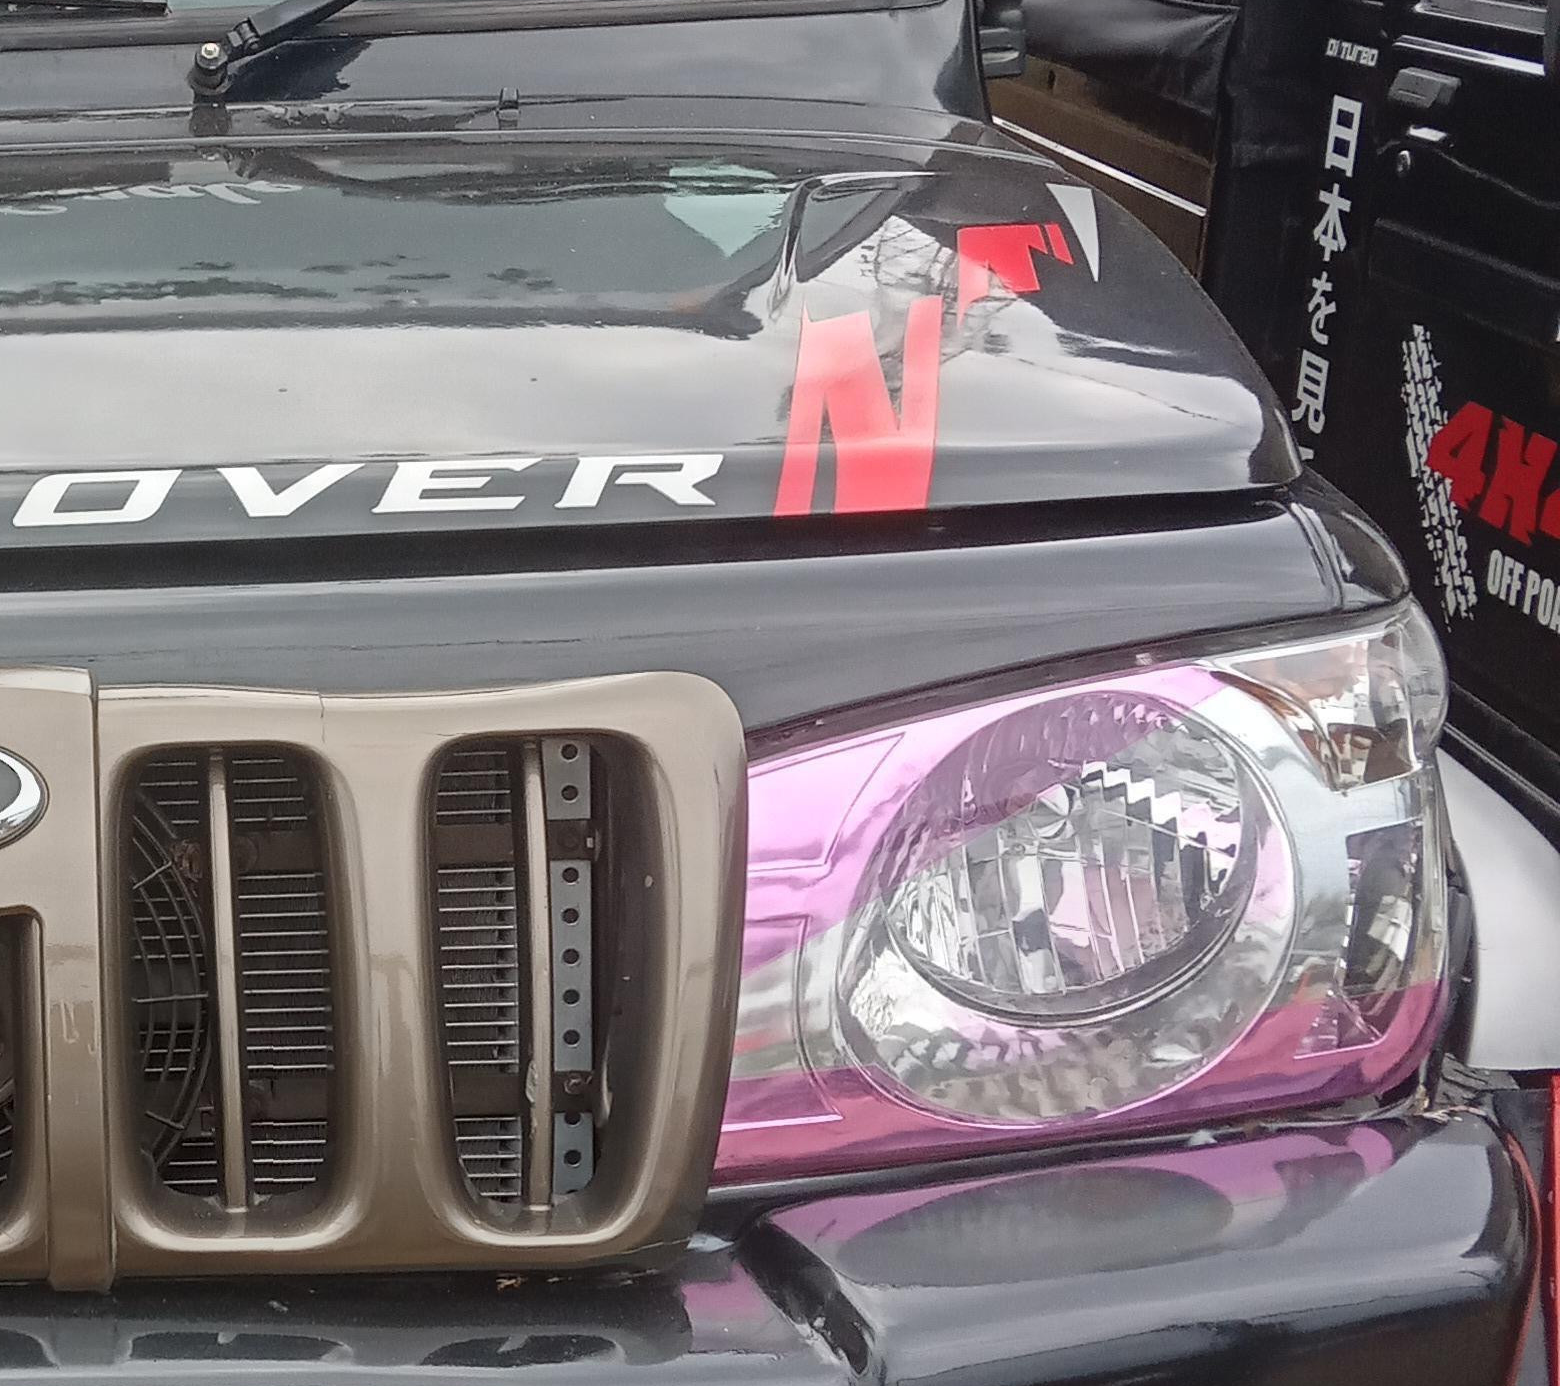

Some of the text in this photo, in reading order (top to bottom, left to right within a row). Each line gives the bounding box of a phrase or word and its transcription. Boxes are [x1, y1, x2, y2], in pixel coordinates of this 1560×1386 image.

[1291, 94, 1363, 461] 日本を見
[1487, 549, 1525, 607] OFF
